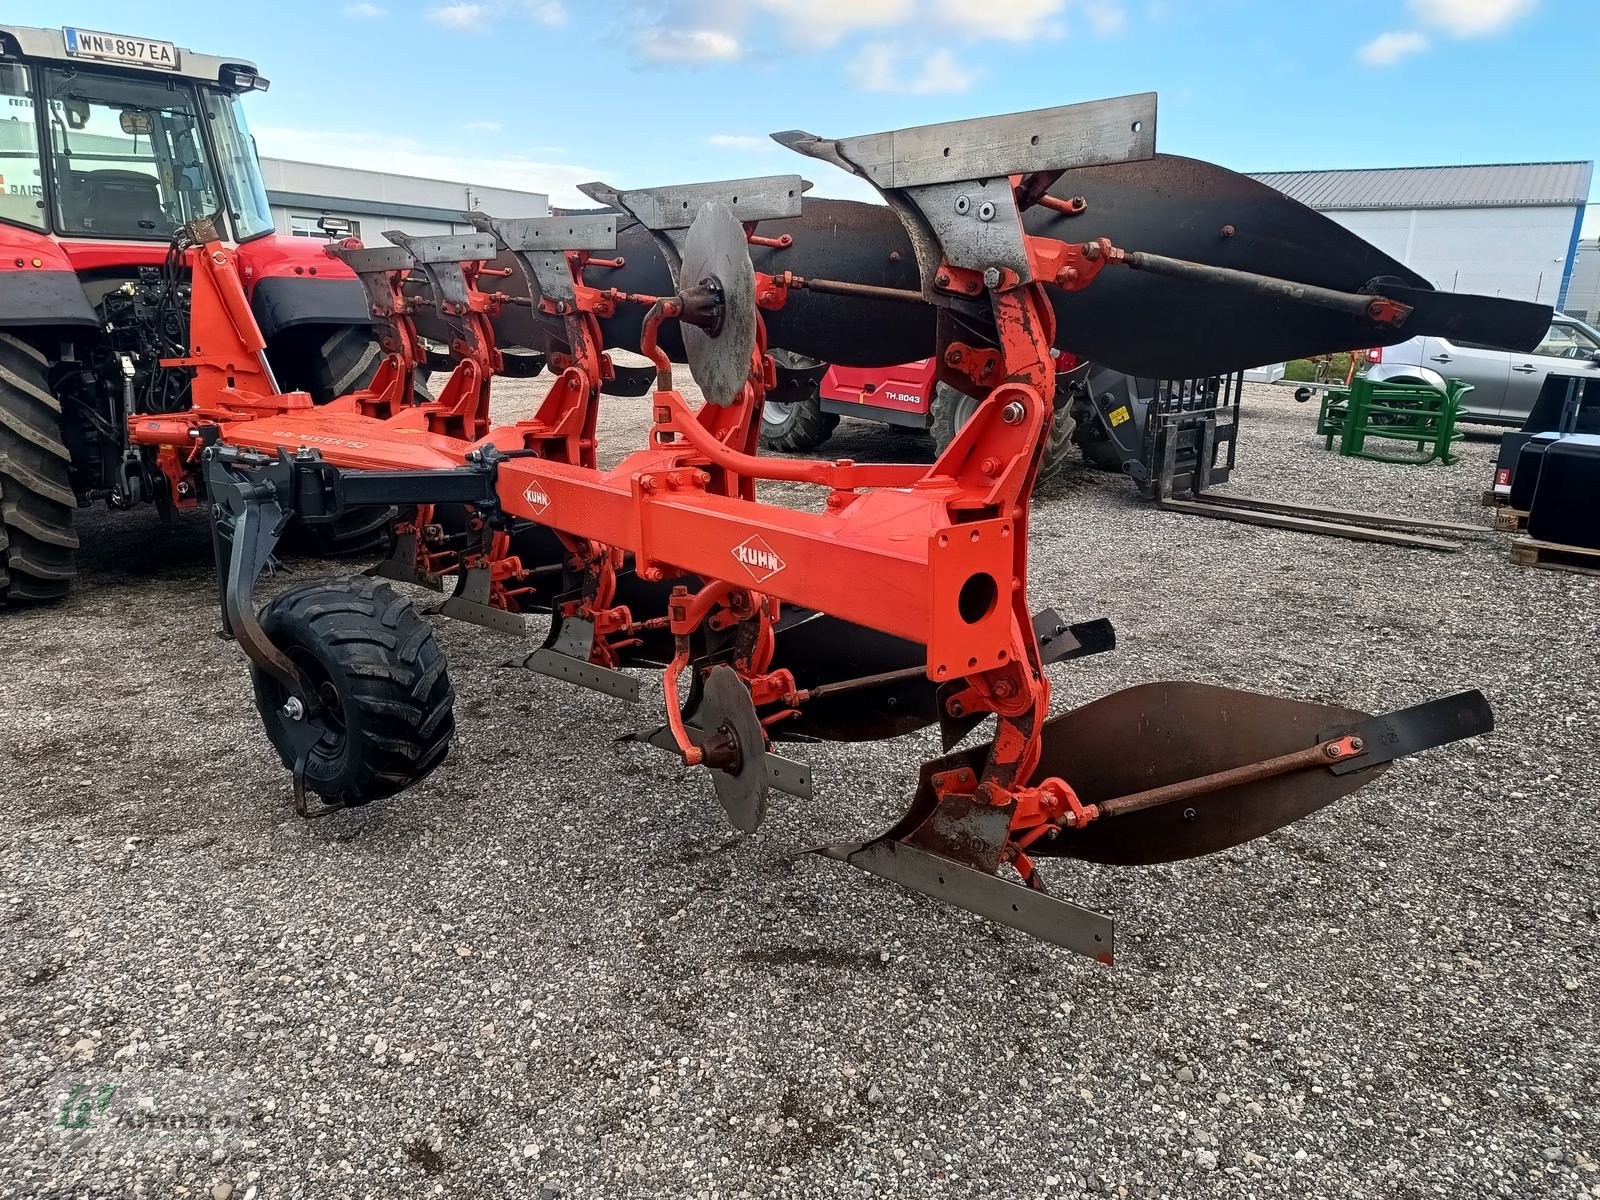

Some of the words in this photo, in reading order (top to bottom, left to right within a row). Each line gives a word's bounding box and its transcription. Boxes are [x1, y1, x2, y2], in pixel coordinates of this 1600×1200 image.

[79, 33, 104, 53] WN
[115, 39, 145, 59] 897
[149, 44, 172, 62] EA
[885, 391, 921, 404] TH.8043
[526, 489, 548, 506] KUHN
[738, 545, 779, 571] KUHN
